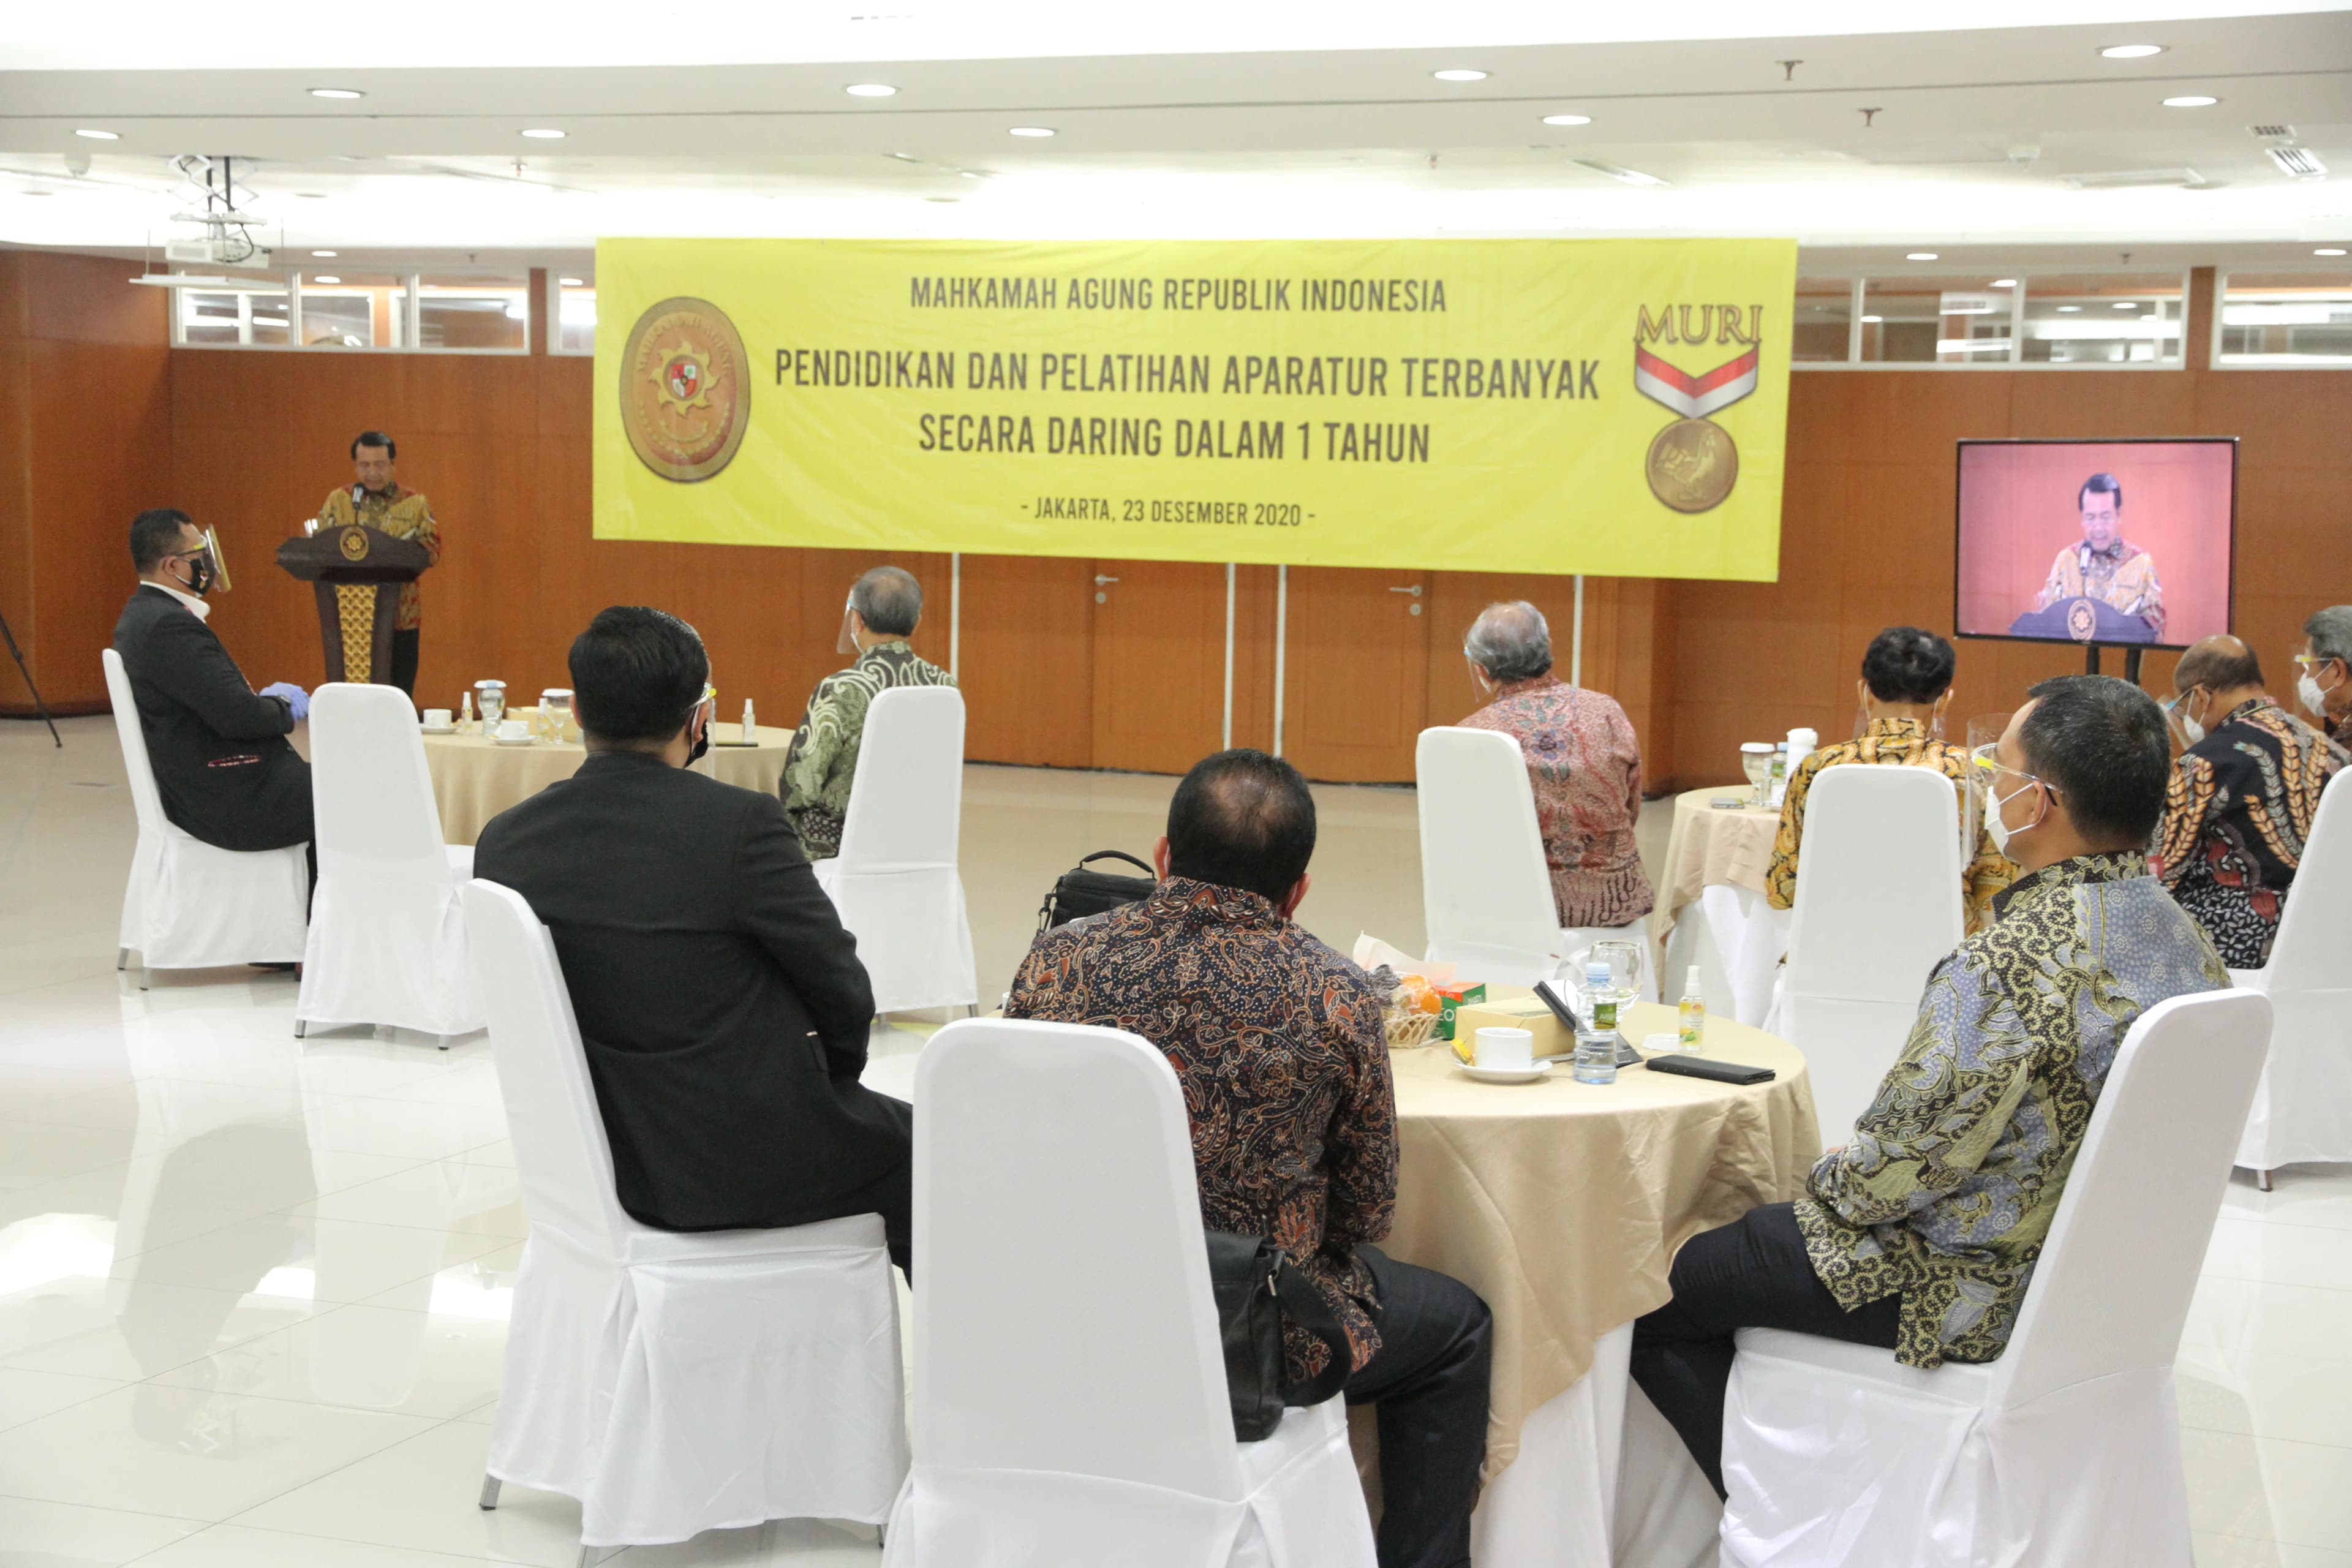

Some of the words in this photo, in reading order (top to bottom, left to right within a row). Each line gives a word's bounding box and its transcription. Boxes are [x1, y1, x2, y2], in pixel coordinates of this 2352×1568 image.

[911, 277, 1056, 309] MAHKAMAH
[1067, 278, 1152, 310] AGUNG
[1164, 279, 1290, 311] REPUBLIK
[1302, 279, 1446, 312] INDONESIA
[1634, 304, 1763, 345] MURI
[775, 349, 954, 389] PENDIDIKAN
[968, 352, 1027, 390] DAN
[1041, 353, 1210, 393] PELATIHAN
[1223, 355, 1387, 396] APARATUR
[1401, 358, 1600, 400] TERBANYAK
[919, 413, 1035, 453] SECARA
[1047, 417, 1162, 457] DARING
[1175, 419, 1284, 460] DALAM
[1297, 421, 1310, 461] 1
[1323, 421, 1430, 463] TAHUN
[1035, 497, 1116, 522] JAKARTA,
[1123, 499, 1144, 522] 23
[1151, 500, 1248, 525] DESEMBER
[1254, 503, 1301, 527] 2020
